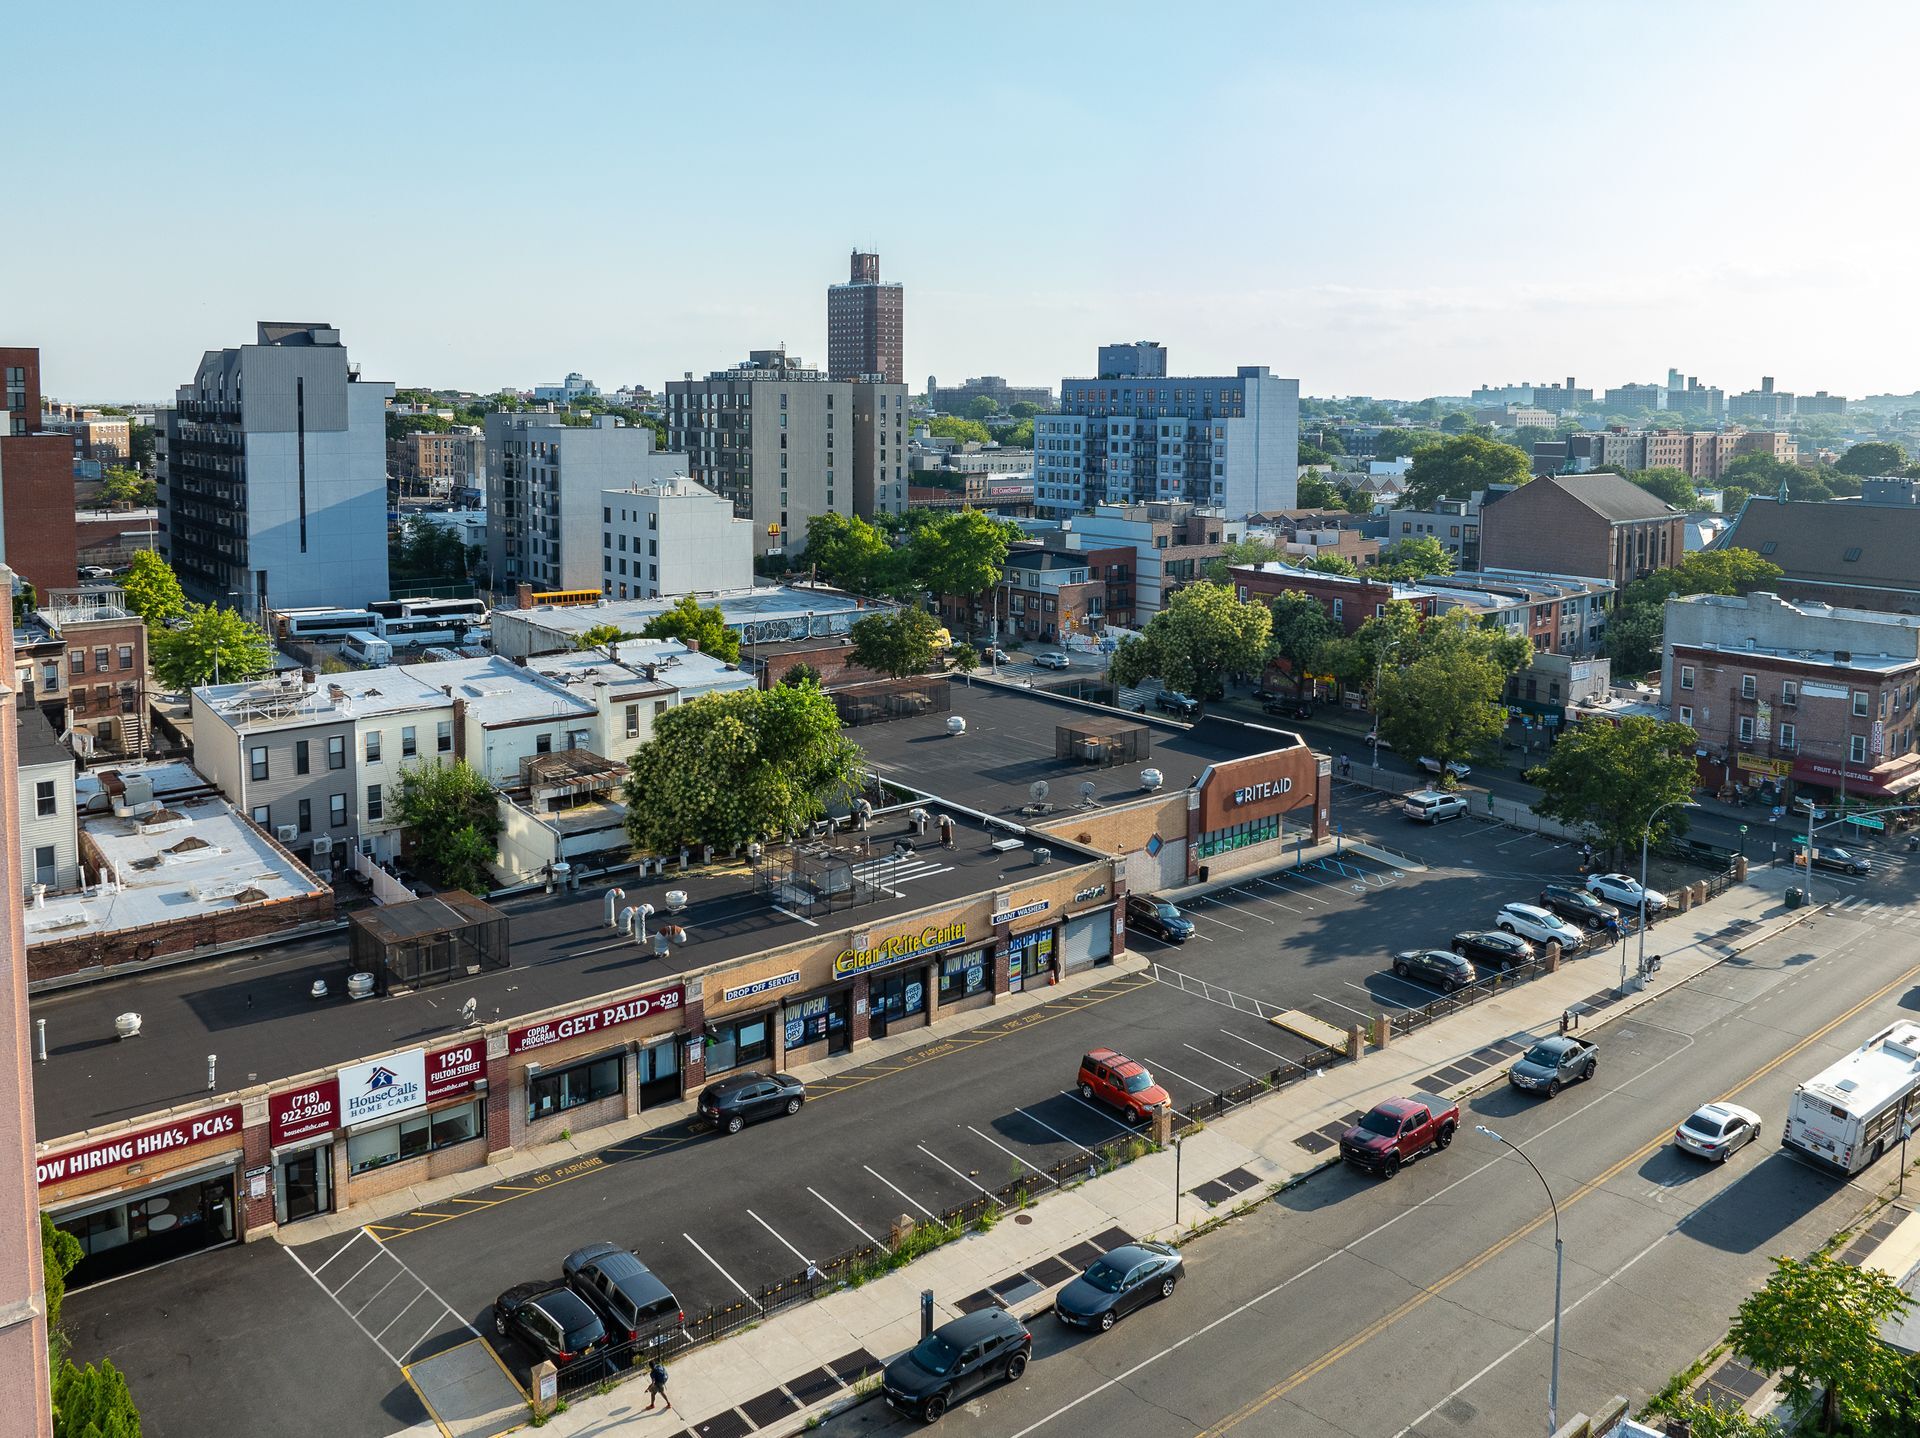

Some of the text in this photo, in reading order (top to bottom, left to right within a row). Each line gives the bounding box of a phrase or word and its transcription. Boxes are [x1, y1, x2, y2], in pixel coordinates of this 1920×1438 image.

[1814, 765, 1831, 774] FRUIT
[1244, 777, 1292, 802] RITE AID
[996, 903, 1045, 923] GIANT WASHERS
[920, 922, 967, 947] Center
[1034, 929, 1052, 942] OFF
[866, 959, 892, 970] Laundry
[893, 952, 917, 962] Service
[917, 942, 951, 955] Superstore
[946, 957, 960, 973] NOW
[962, 950, 983, 967] OPEN!
[967, 967, 981, 978] FREE
[968, 975, 980, 985] DRY
[727, 973, 798, 1000] DROP OFF SERVICE
[906, 984, 921, 995] FREE
[660, 992, 679, 1008] $20
[907, 992, 919, 1002] DRY
[785, 996, 827, 1021] NOW OPEN!
[558, 999, 650, 1039] GET PAID
[786, 1020, 802, 1033] FREE
[521, 1031, 556, 1047] PROGRAM
[527, 1024, 549, 1037] CDPAP
[787, 1030, 801, 1040] DRY
[439, 1047, 473, 1068] 1950
[431, 1061, 481, 1082] FULTON STREET
[349, 1082, 418, 1110] HouseCalls
[427, 1080, 469, 1097] housecallshc.com
[292, 1091, 320, 1109] (718)
[351, 1093, 417, 1118] HOME CARE
[281, 1101, 331, 1124] 922-9200
[36, 1115, 234, 1183] OW HIRING HHA's, PCA's
[533, 1157, 603, 1184] NO PARKING
